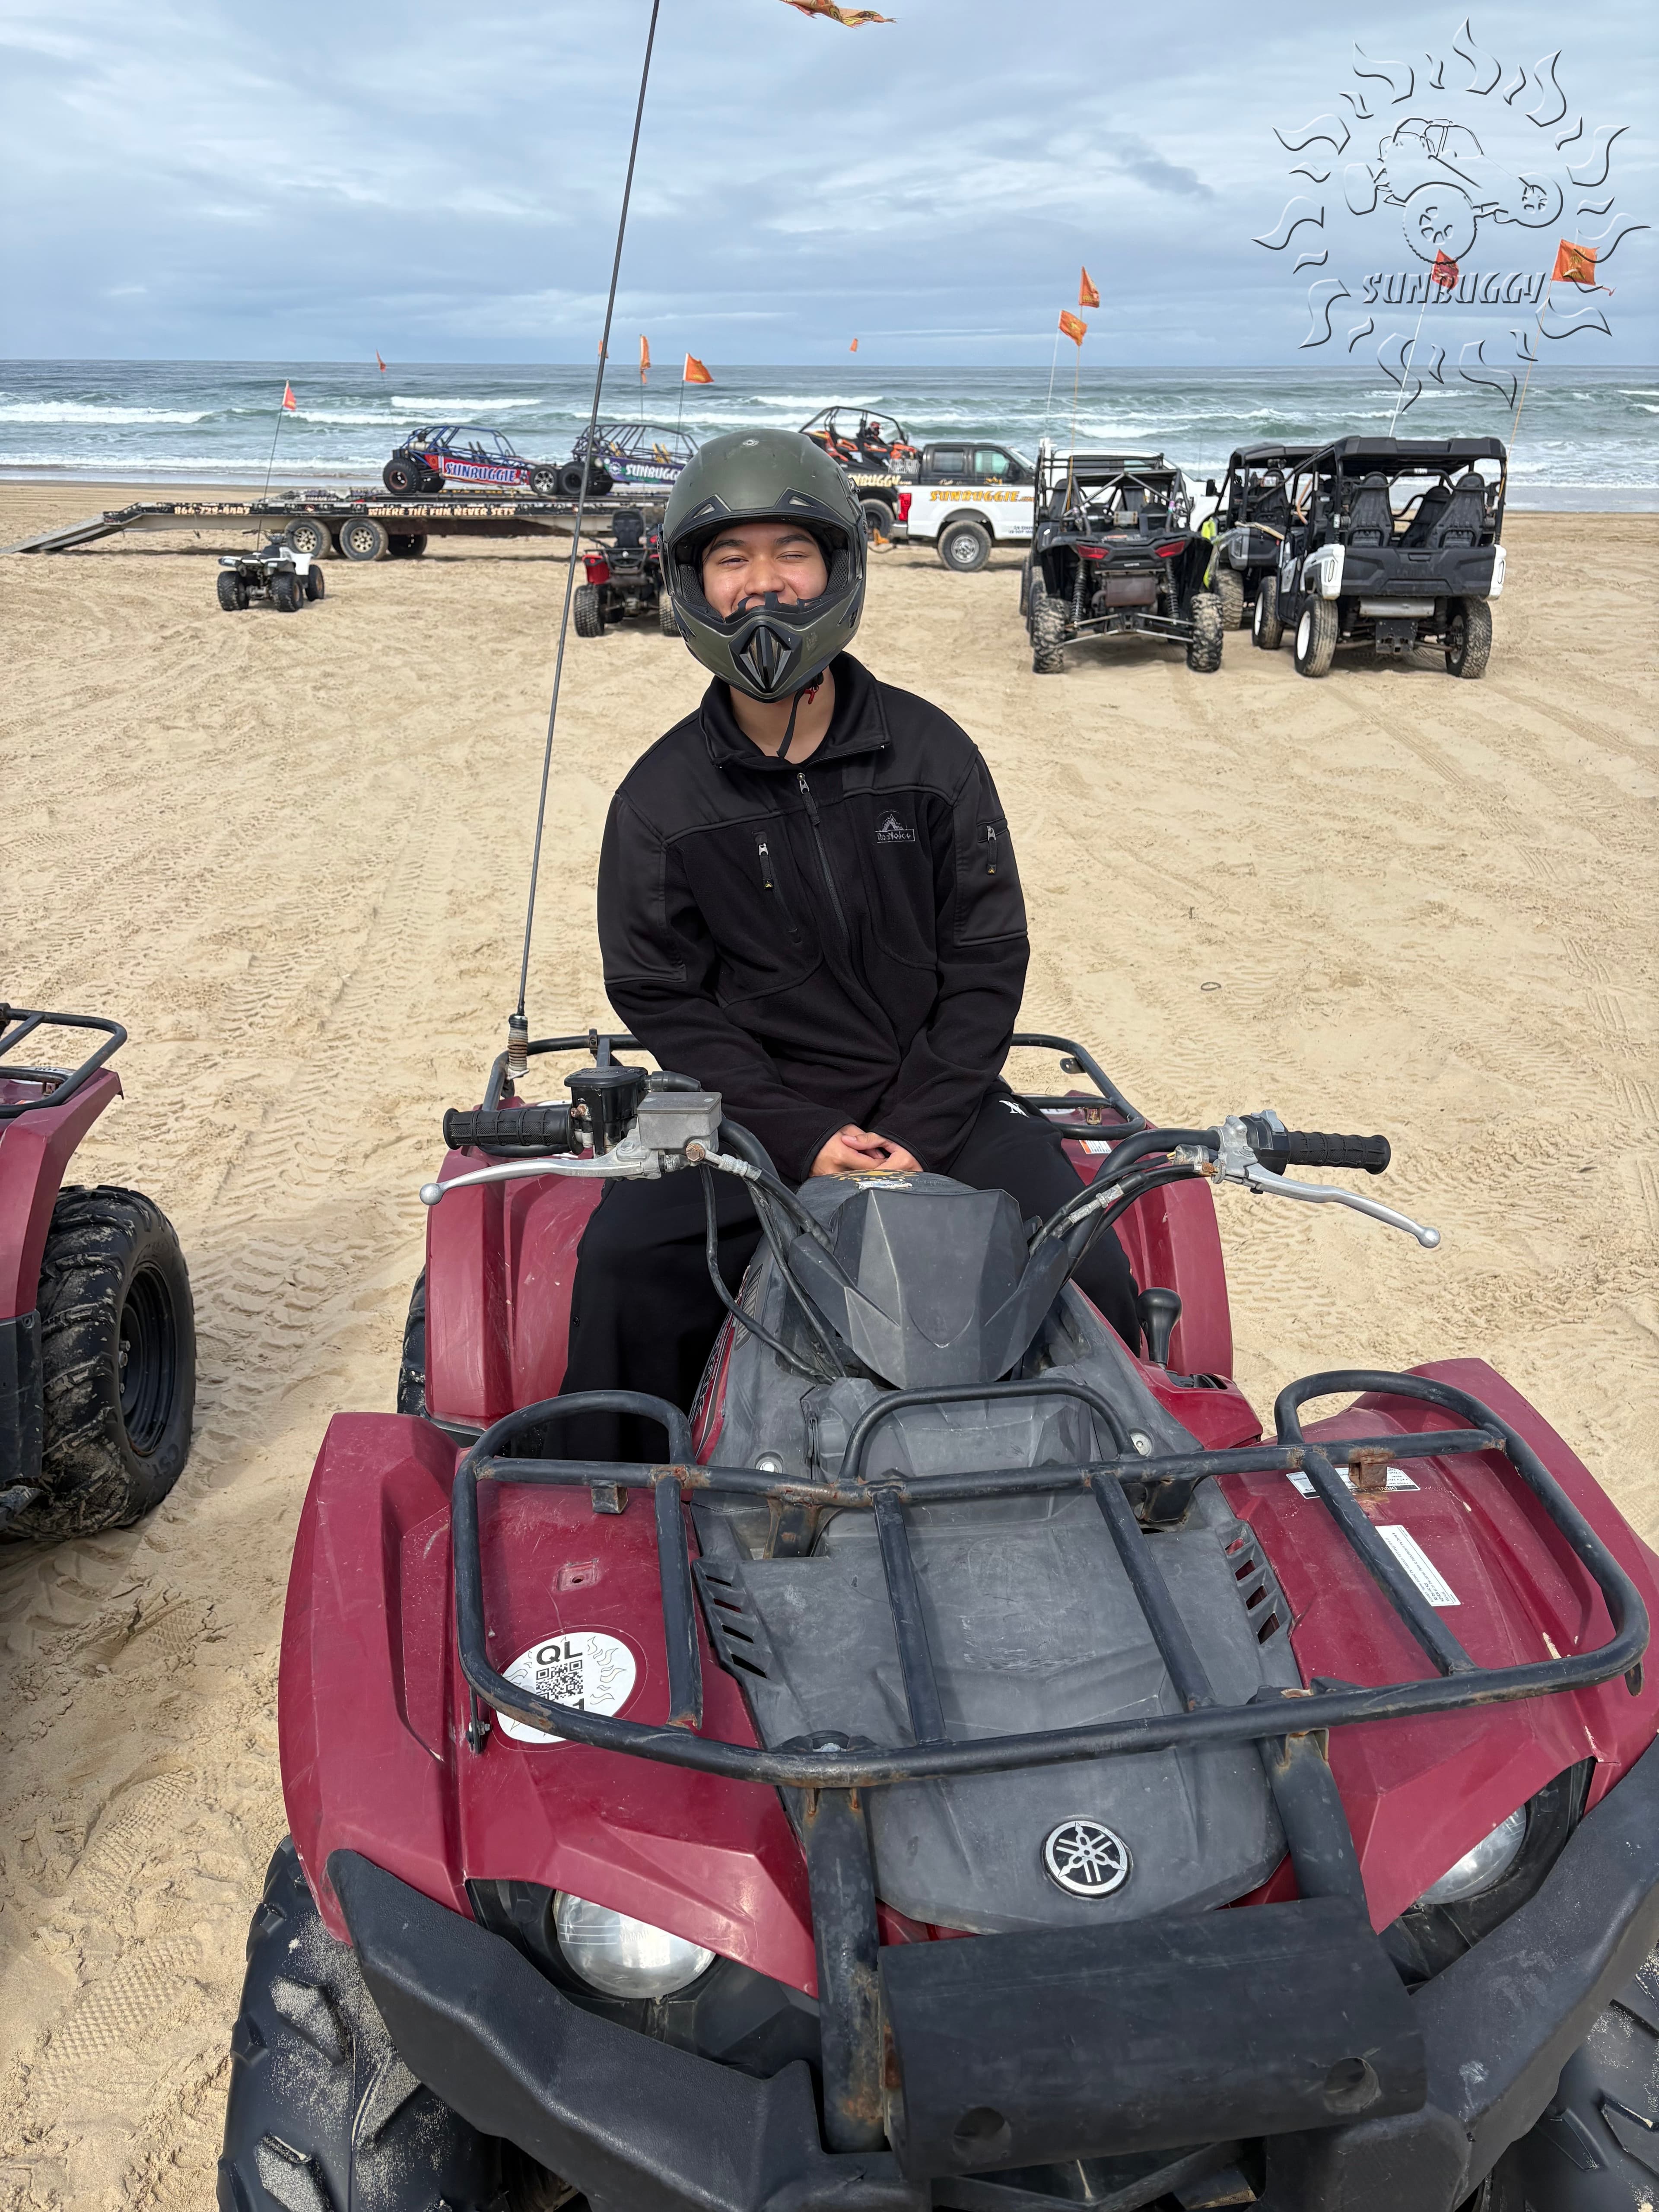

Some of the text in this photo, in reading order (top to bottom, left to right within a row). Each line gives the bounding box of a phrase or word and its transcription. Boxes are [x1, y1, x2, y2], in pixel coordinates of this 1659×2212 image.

[445, 461, 516, 483] SUNBUGGIE
[625, 464, 681, 481] SUNBUGG
[368, 507, 516, 516] WHERE THE FUN NEVER SETS
[537, 1641, 582, 1665] QL
